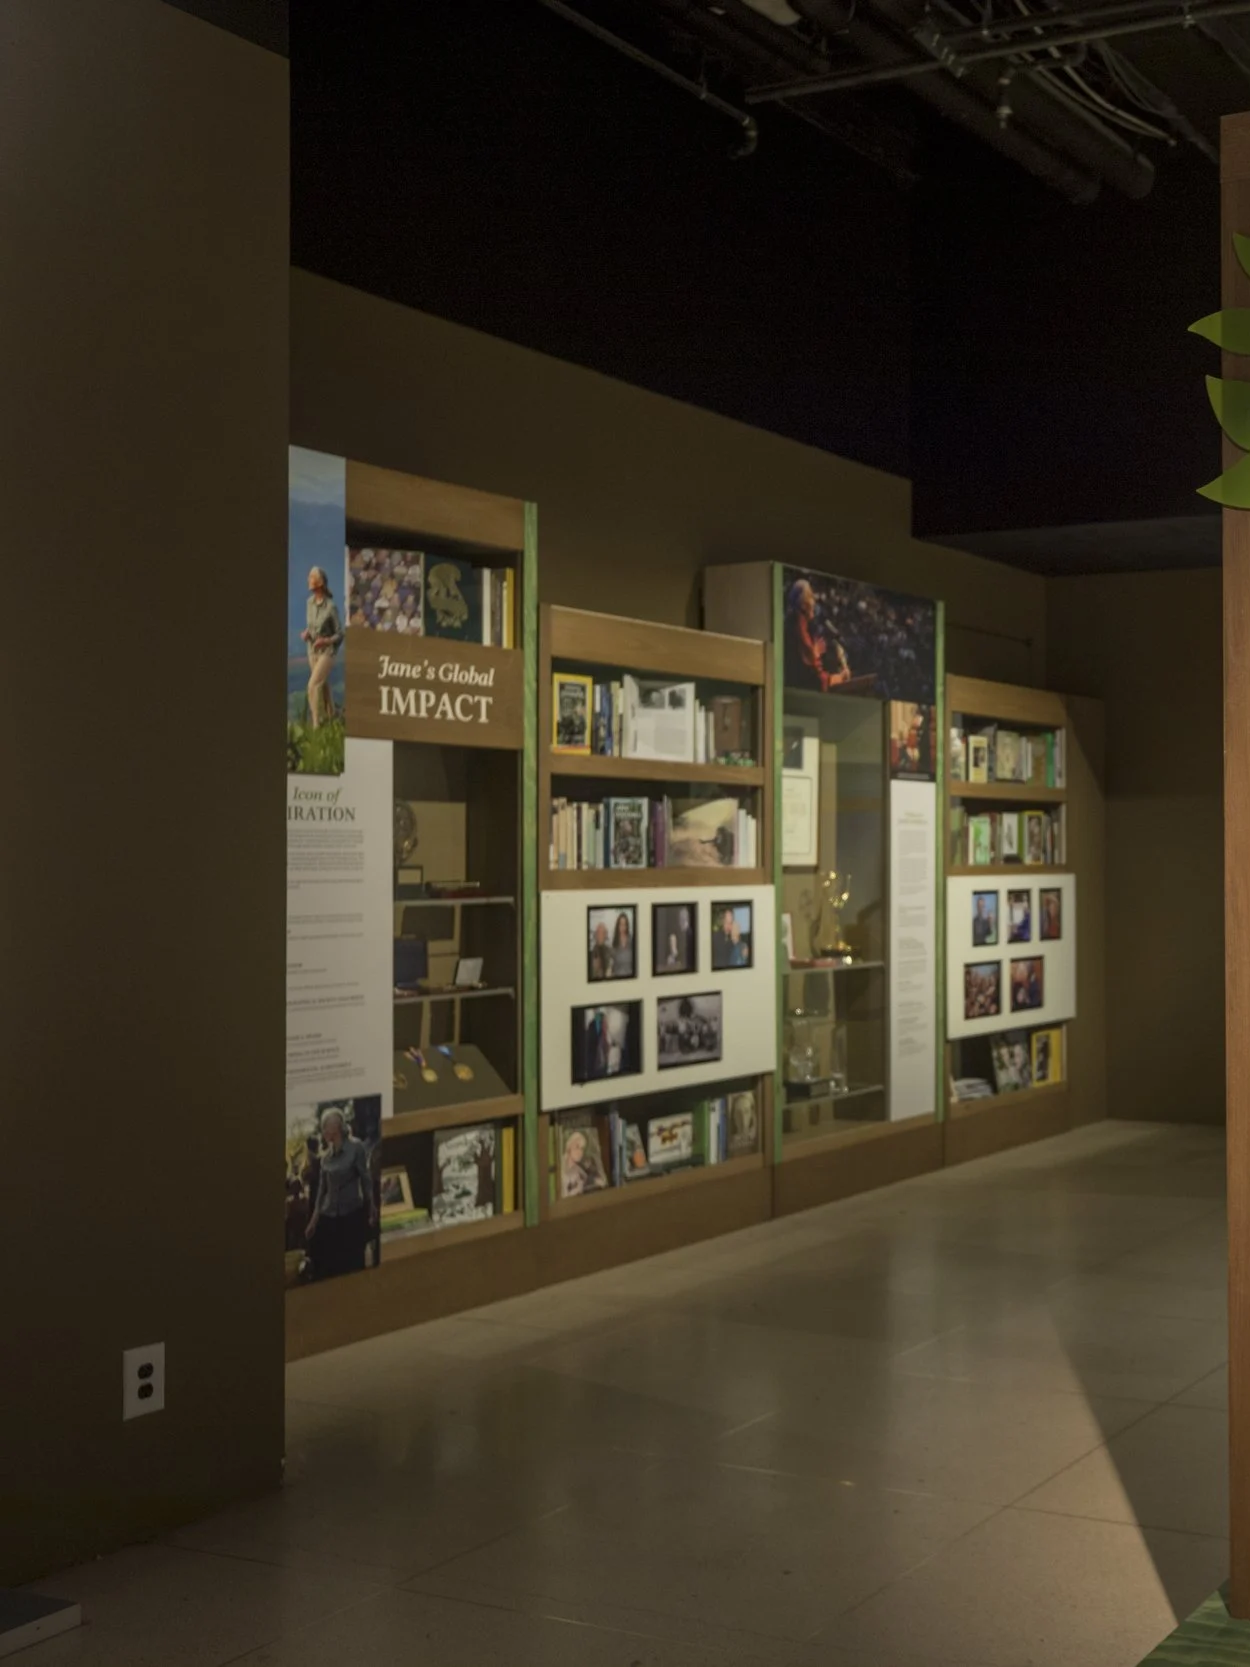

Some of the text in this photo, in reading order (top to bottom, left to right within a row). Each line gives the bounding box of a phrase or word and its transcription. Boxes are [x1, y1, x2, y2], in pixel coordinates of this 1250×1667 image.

[378, 655, 495, 688] Jane's Global
[379, 686, 493, 724] IMPACT
[293, 786, 342, 805] Icon of
[287, 805, 356, 821] IRATION
